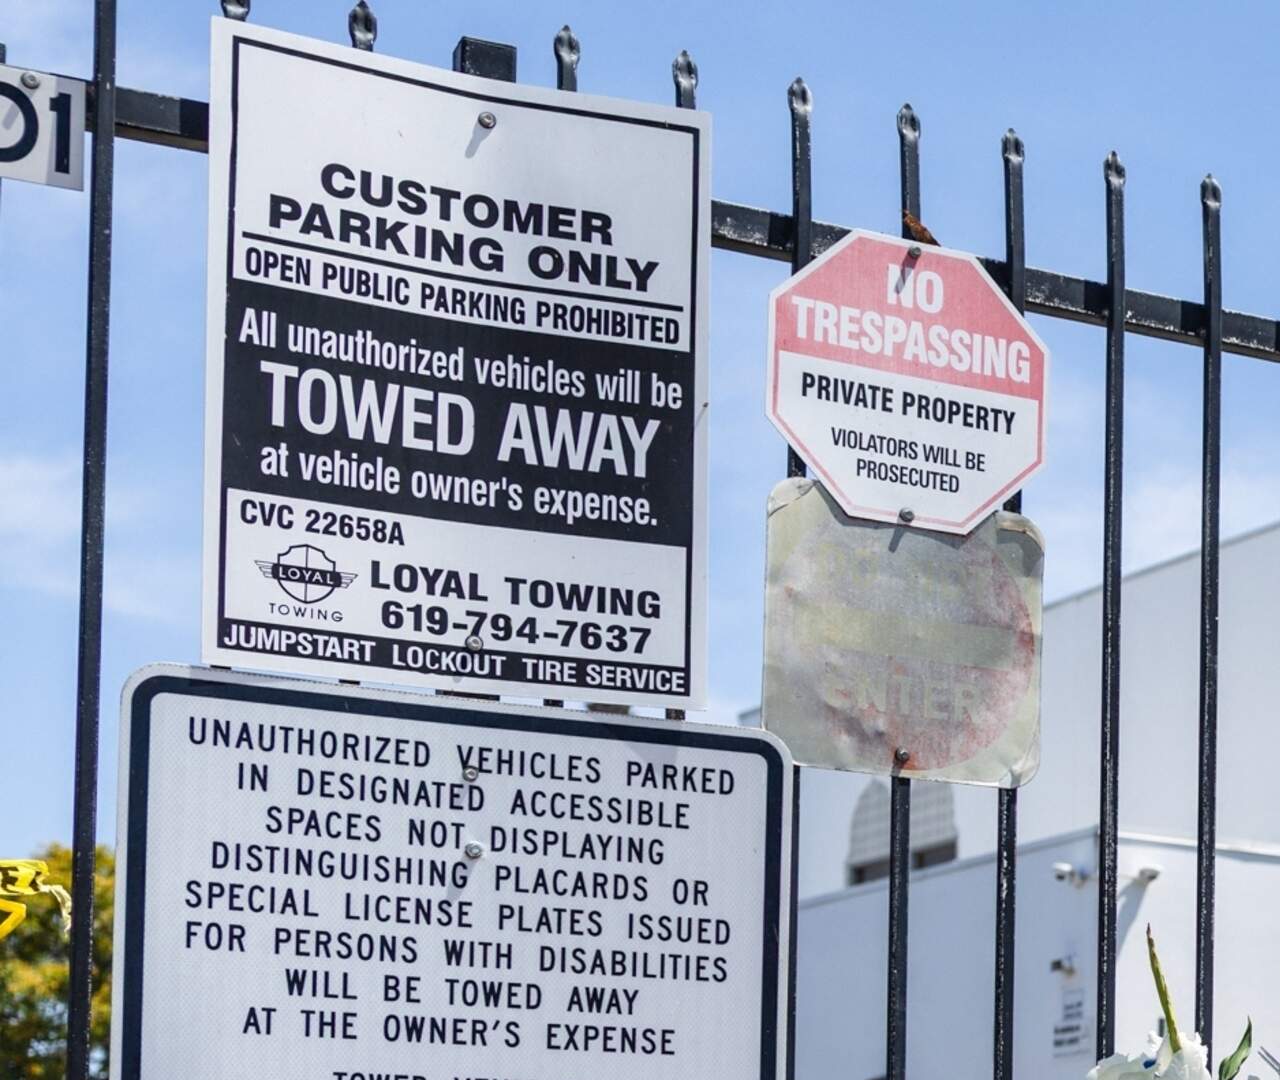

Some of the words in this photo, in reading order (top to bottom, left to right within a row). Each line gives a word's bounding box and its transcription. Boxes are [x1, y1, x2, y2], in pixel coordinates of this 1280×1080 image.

[321, 164, 612, 246] CUSTOMER
[269, 194, 504, 272] PARKING
[528, 246, 659, 292] ONLY
[246, 247, 310, 286] OPEN
[323, 262, 409, 305] PUBLIC
[421, 283, 525, 324] PARKING
[537, 301, 679, 344] PROHIBITED
[886, 263, 944, 314] NO
[239, 308, 276, 348] All
[288, 324, 463, 381] unauthorized
[474, 355, 585, 397] vehicles
[596, 369, 640, 404] will
[652, 373, 682, 409] be
[791, 295, 1030, 384] TRESPASSING
[261, 361, 474, 455] TOWED
[498, 403, 660, 477] AWAY
[801, 371, 894, 413] PRIVATE
[902, 390, 1016, 435] PROPERTY
[831, 426, 918, 460] VIOLATORS
[923, 443, 961, 468] WILL
[965, 451, 985, 472] BE
[856, 458, 960, 493] PROSECUTED
[261, 443, 288, 477] at
[299, 450, 400, 494] vehicle
[412, 471, 522, 510] owner's
[534, 487, 657, 525] expense.
[241, 499, 293, 529] CVC
[305, 509, 404, 545] 22658A
[279, 567, 333, 584] LOYAL
[371, 560, 488, 601] LOYAL
[505, 577, 660, 618] TOWING
[270, 603, 343, 622] TOWING
[382, 601, 651, 654] 619-794-7637
[224, 625, 376, 661] JUMPSTART
[393, 644, 506, 676] LOCKOUT
[522, 658, 576, 682] TIRE
[586, 664, 684, 692] SERVICE
[189, 717, 430, 767] UNAUTHORIZED
[457, 745, 600, 783] VEHICLES
[627, 761, 734, 795] PARKED
[239, 763, 268, 791] IN
[298, 768, 484, 811] DESIGNATED
[511, 789, 689, 829] ACCESSIBLE
[266, 806, 381, 842] SPACES
[409, 819, 465, 849] NOT
[491, 826, 663, 865] DISPLAYING
[212, 842, 468, 889] DISTINGUISHING
[496, 866, 647, 901] PLACARDS
[673, 879, 708, 906] OR
[185, 880, 318, 917] SPECIAL
[346, 893, 472, 928] LICENSE
[499, 905, 602, 937] PLATES
[629, 914, 730, 945] ISSUED
[186, 921, 245, 952] FOR
[275, 928, 417, 963] PERSONS
[444, 940, 512, 969] WITH
[540, 946, 727, 982] DISABILITIES
[286, 969, 357, 999] WILL
[384, 975, 420, 1003] BE
[445, 979, 541, 1009] TOWED
[567, 987, 638, 1015] AWAY
[243, 1007, 276, 1035] AT
[301, 1010, 357, 1039] THE
[384, 1015, 520, 1047] OWNER'S
[547, 1024, 675, 1055] EXPENSE
